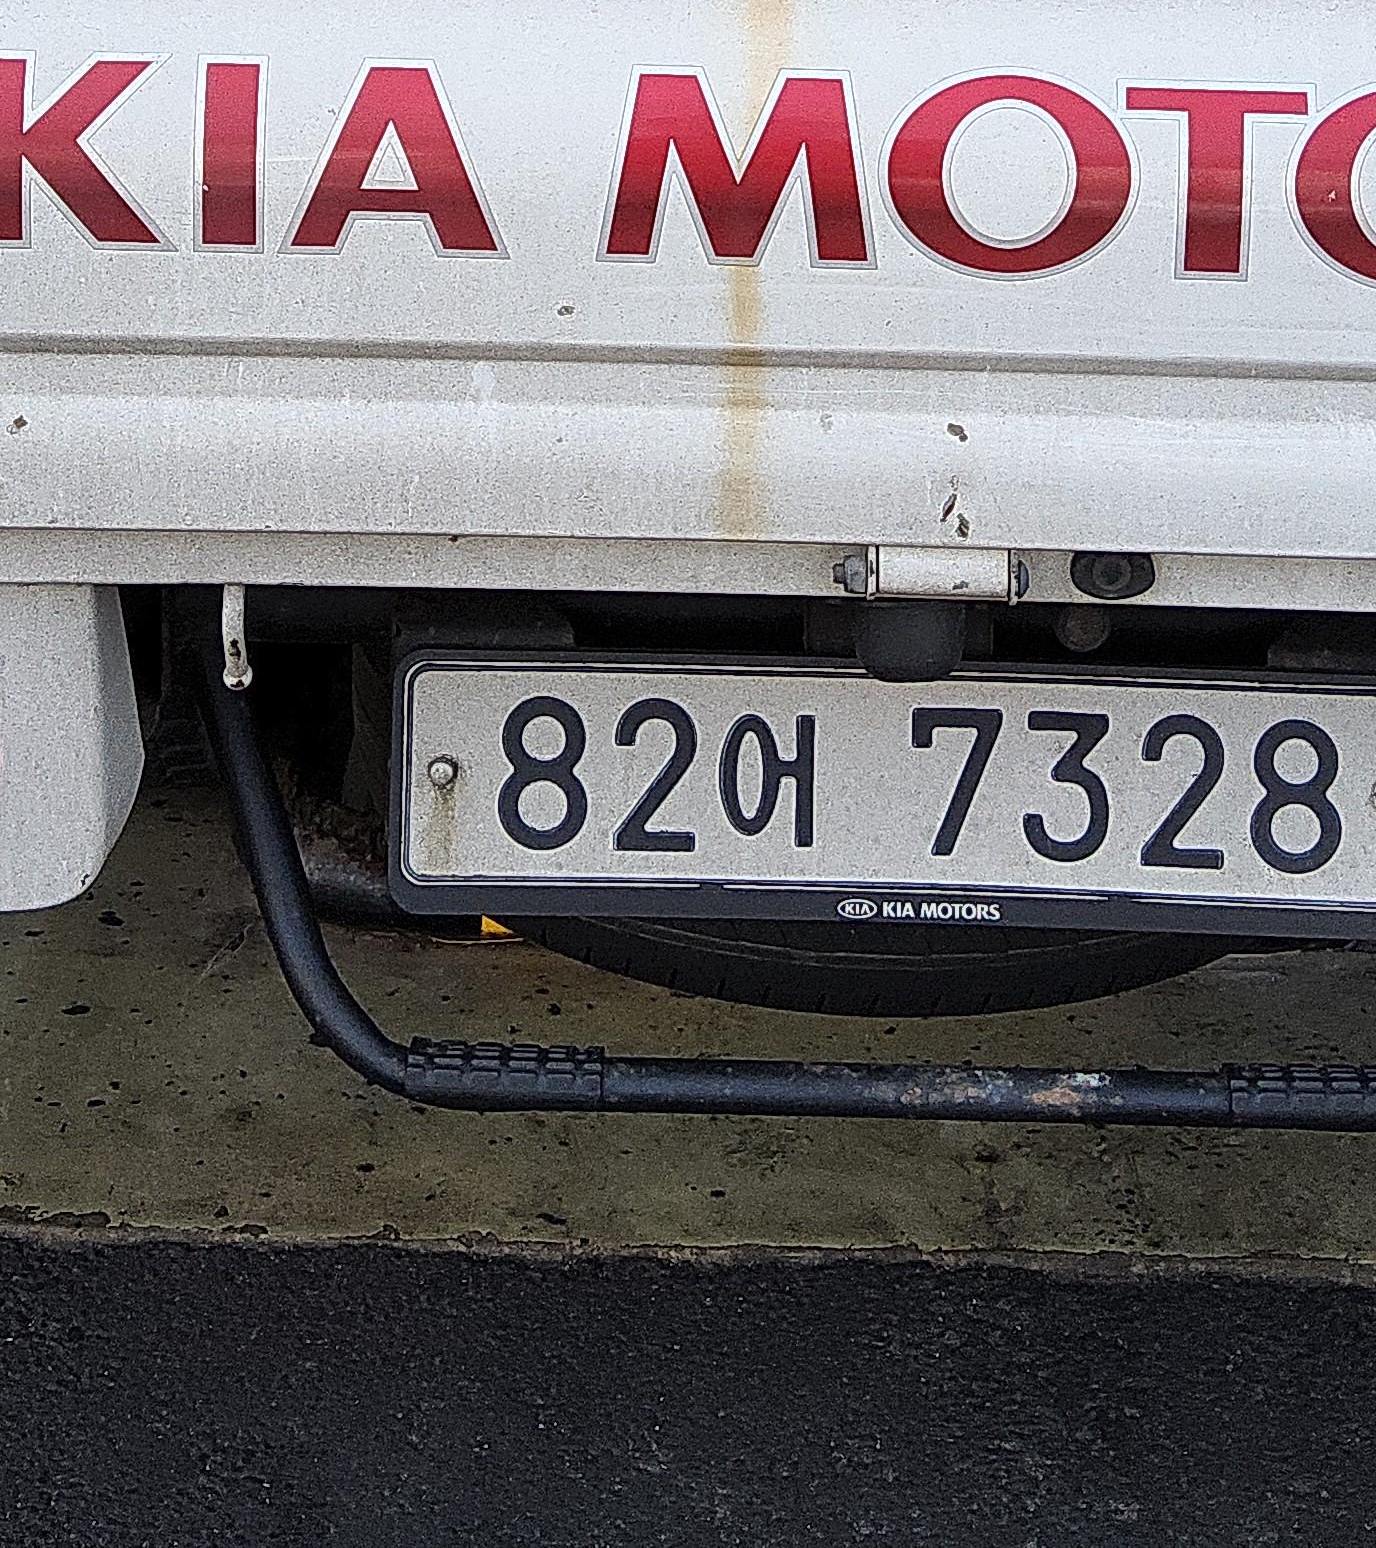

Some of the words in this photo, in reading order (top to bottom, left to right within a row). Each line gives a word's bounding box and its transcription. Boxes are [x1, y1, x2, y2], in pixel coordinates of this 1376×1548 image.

[495, 694, 817, 854] 82어
[909, 705, 1345, 875] 7328
[844, 902, 872, 916] KIA
[882, 901, 916, 919] KIA
[919, 902, 1002, 921] MOTORS
